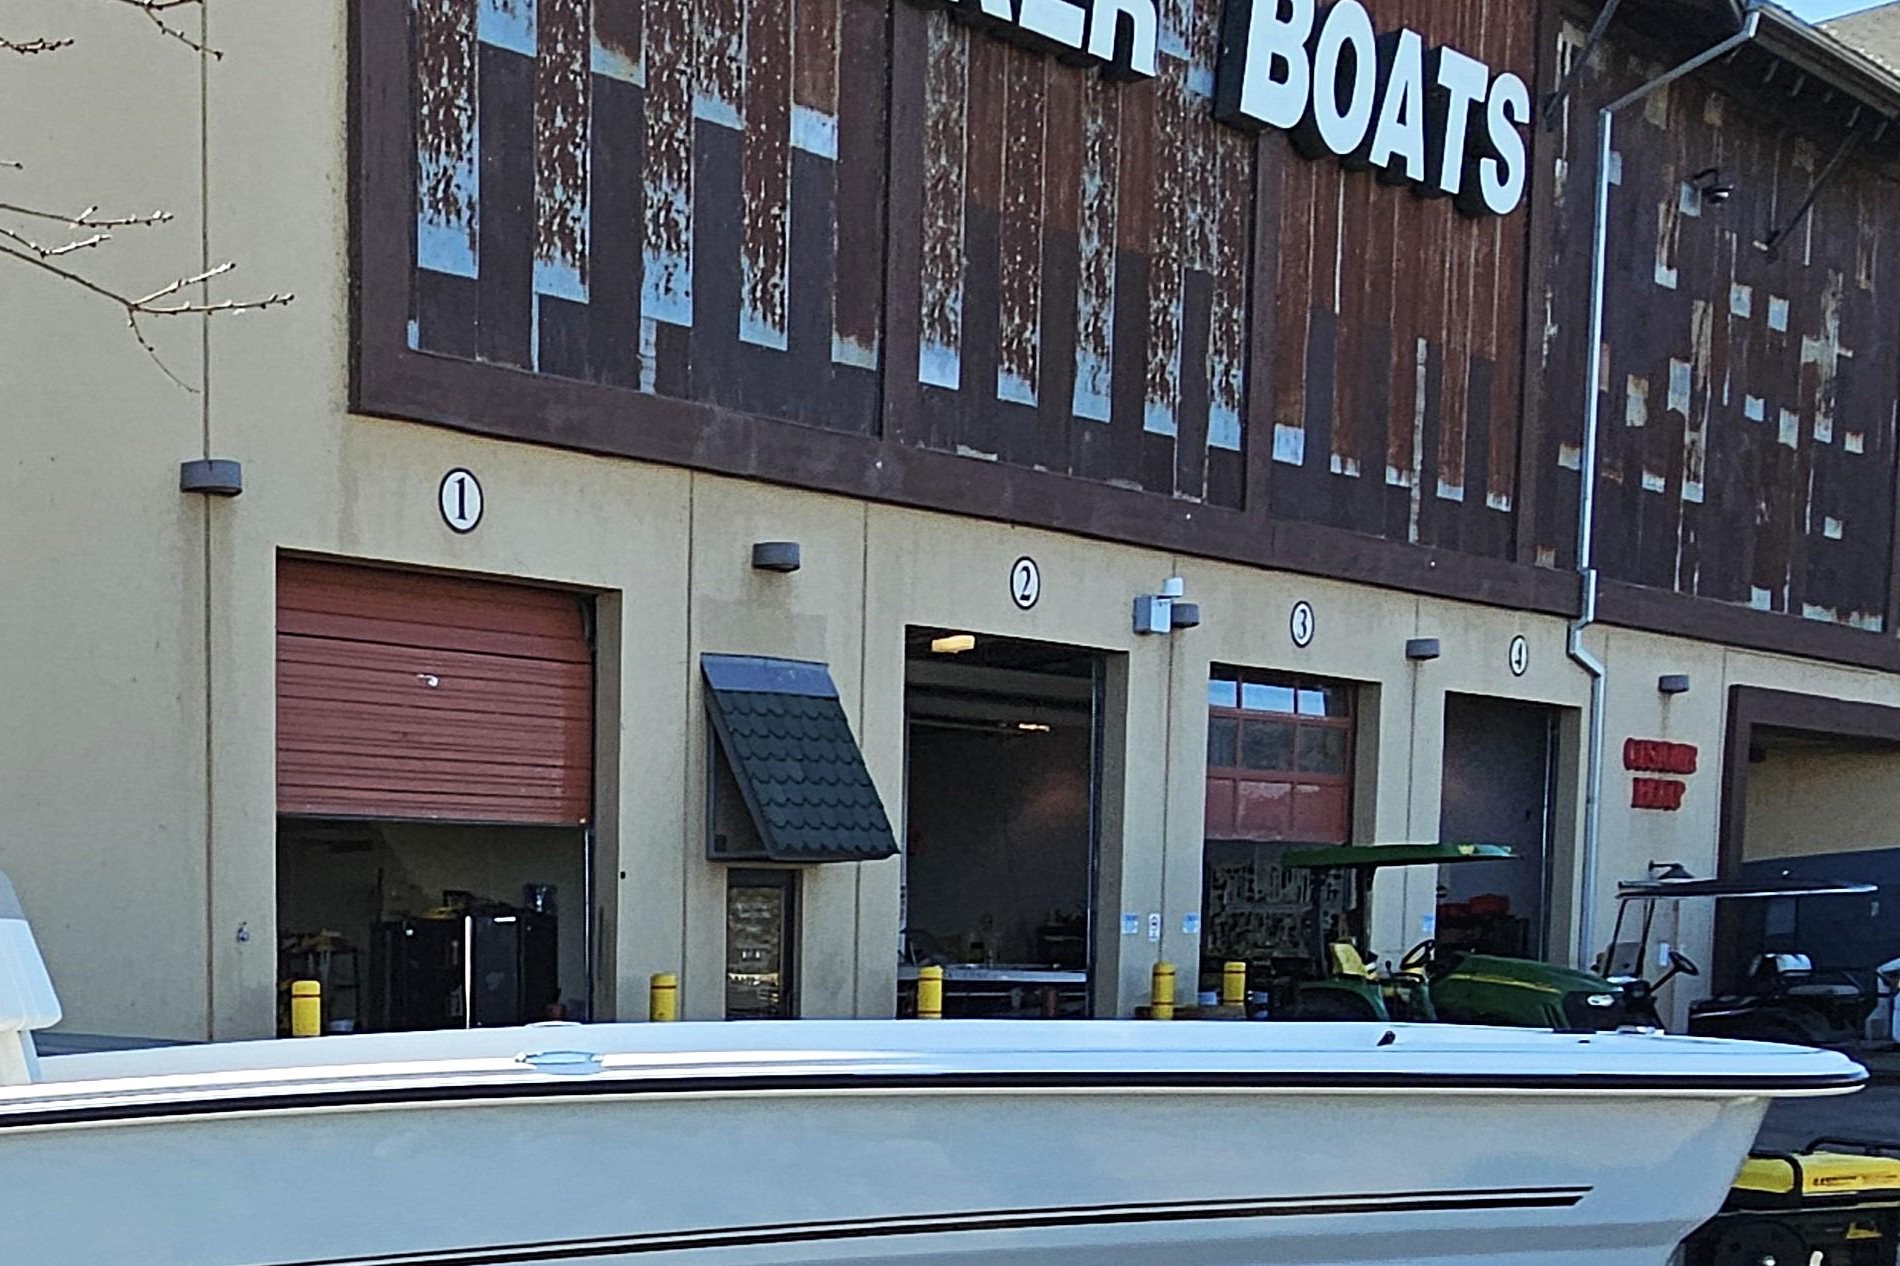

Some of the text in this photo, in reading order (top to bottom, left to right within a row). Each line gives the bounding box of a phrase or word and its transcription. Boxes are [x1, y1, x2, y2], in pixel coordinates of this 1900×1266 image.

[1240, 0, 1531, 215] BOATS
[453, 476, 468, 521] 1
[1019, 565, 1032, 602] 2
